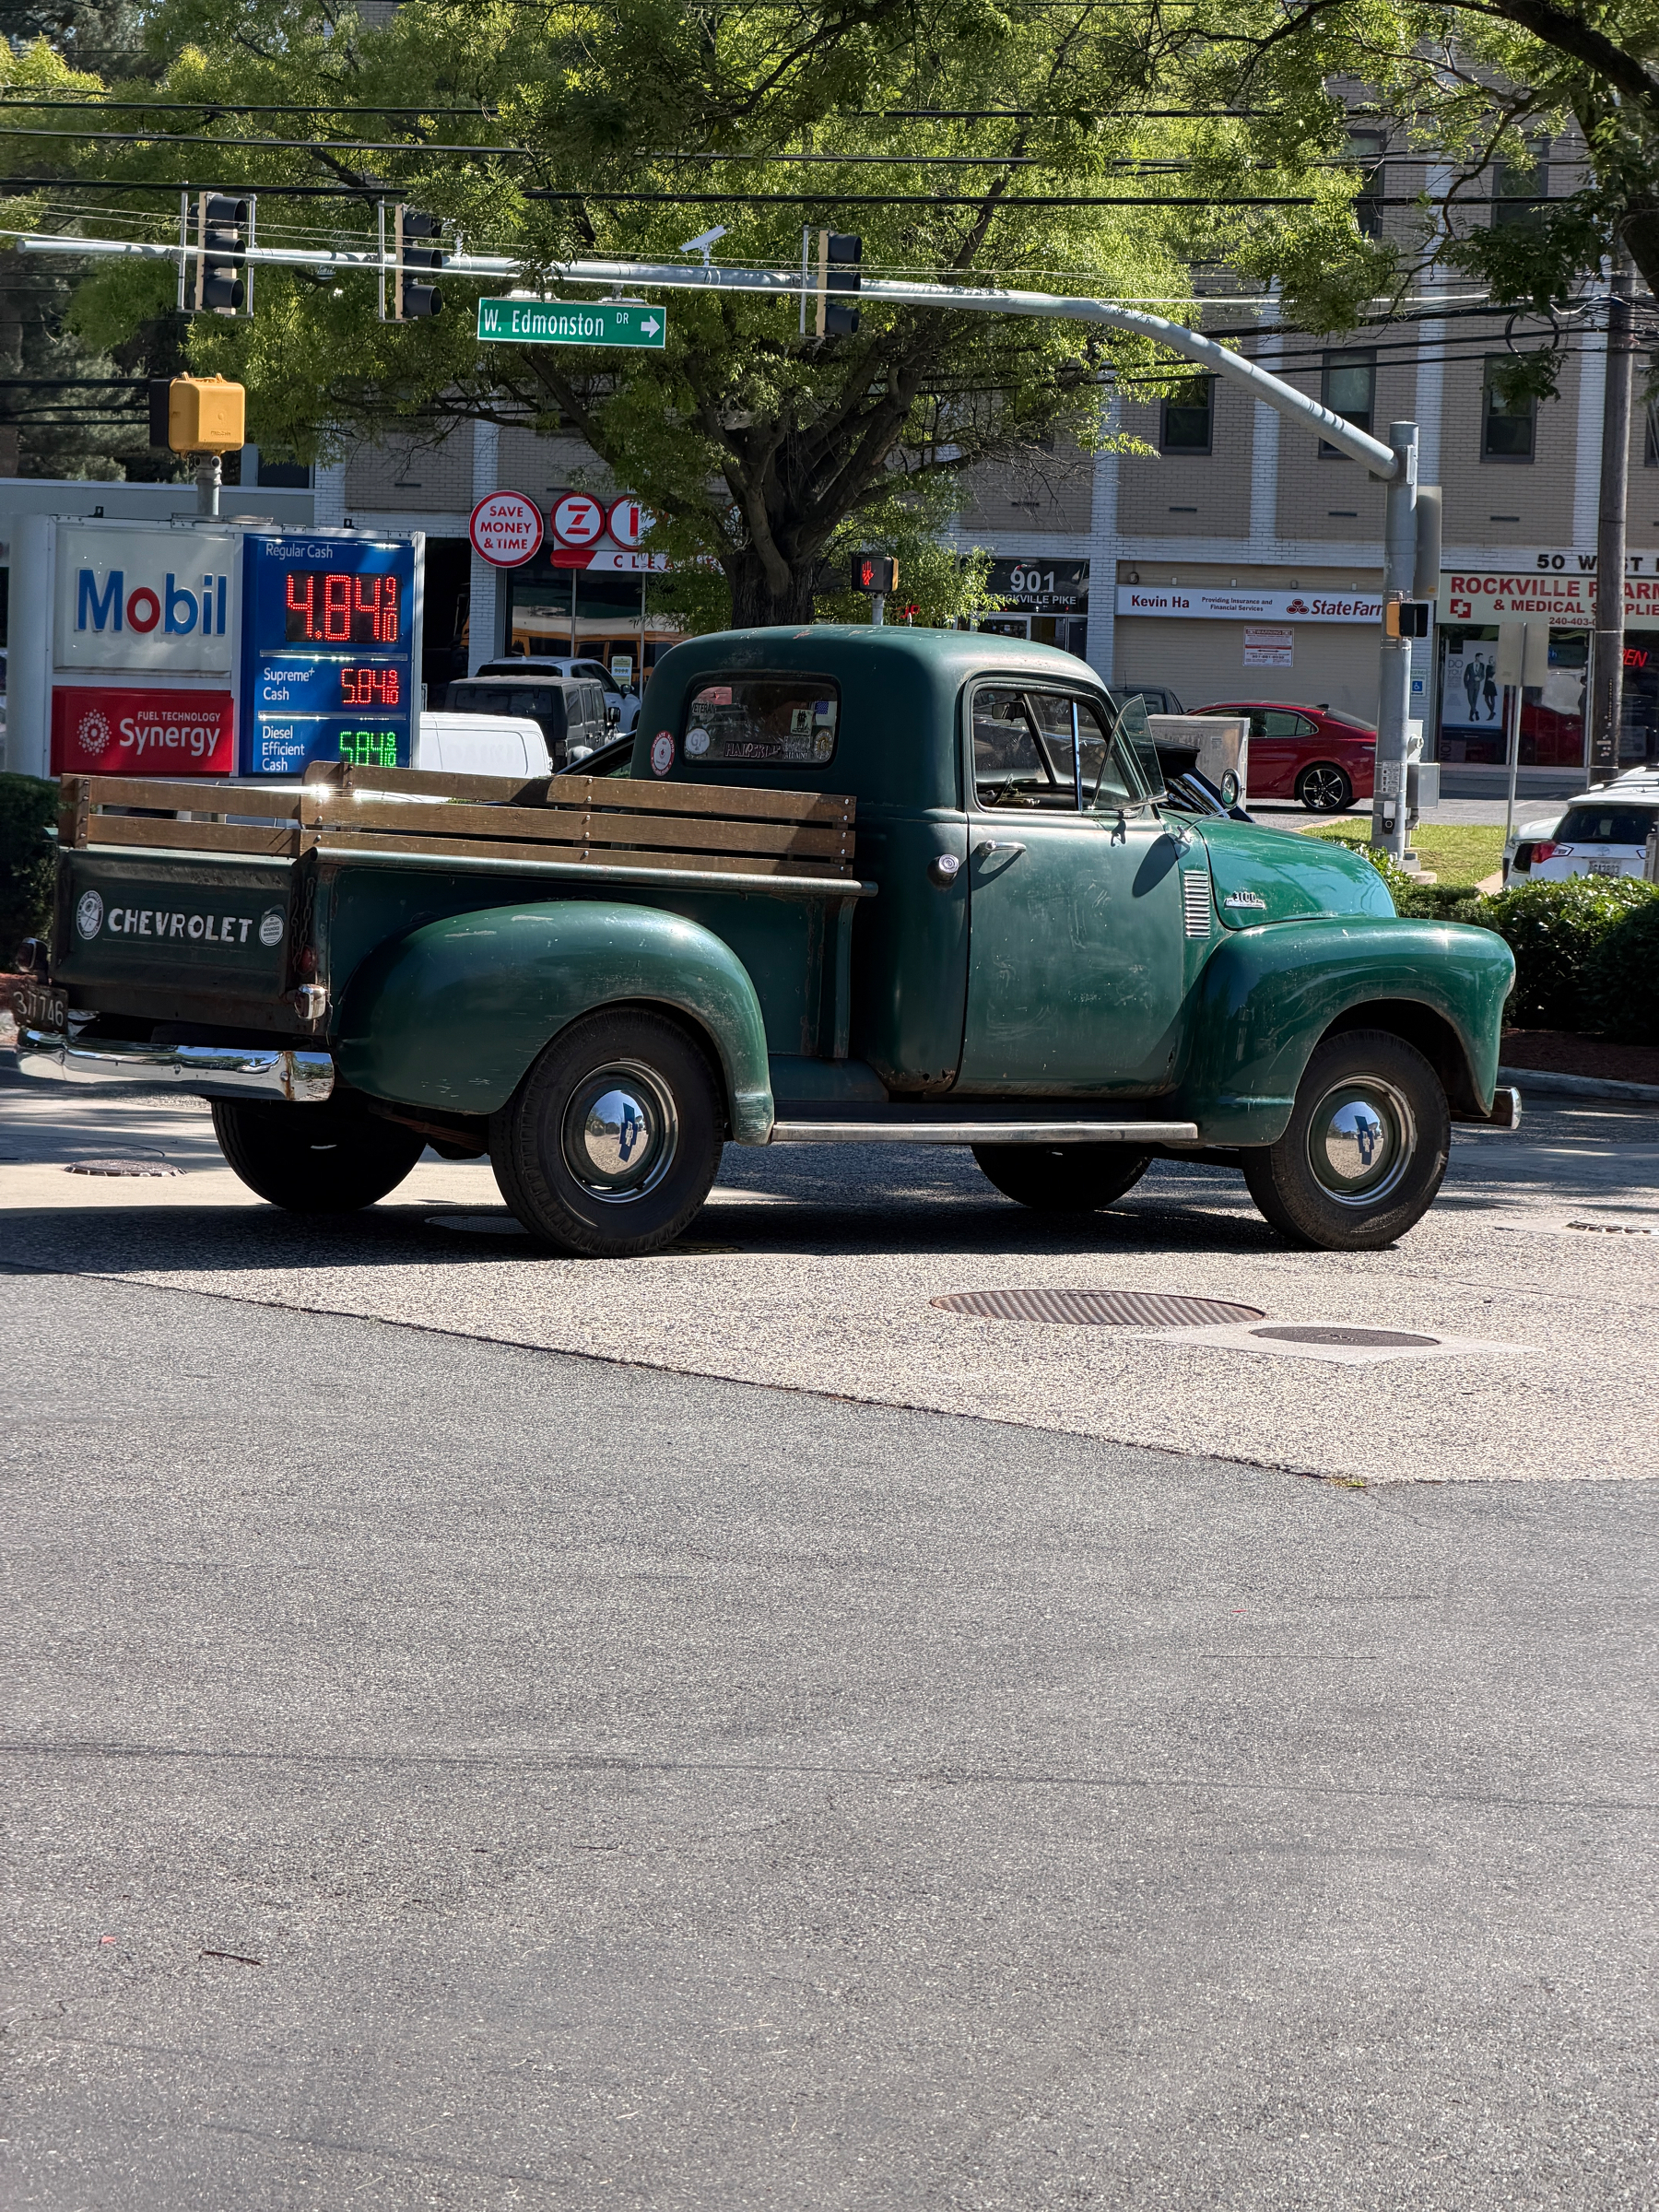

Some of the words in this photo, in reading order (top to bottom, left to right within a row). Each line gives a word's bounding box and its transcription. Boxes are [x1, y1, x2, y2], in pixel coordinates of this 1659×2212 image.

[484, 309, 501, 332] W.
[512, 309, 604, 336] Edmonston
[616, 312, 629, 324] DR
[489, 506, 524, 517] SAVE
[480, 522, 533, 534] MONEY
[484, 538, 493, 548] &
[496, 539, 528, 550] TIME
[265, 543, 305, 560] Regular
[307, 545, 333, 559] Cash
[1537, 554, 1565, 570] 50
[1010, 571, 1054, 592] 901
[1451, 577, 1580, 597] ROCKVILLE
[76, 569, 227, 636] Mobil
[1052, 595, 1077, 605] PIKE
[1131, 595, 1167, 607] Kevin
[1171, 596, 1190, 608] Ha
[1202, 596, 1230, 605] Providing
[1493, 599, 1505, 611] &
[1512, 600, 1585, 614] MEDICAL
[1448, 659, 1464, 669] DO
[263, 687, 289, 700] Cash
[137, 711, 159, 721] FUEL
[161, 712, 221, 723] TECHNOLOGY
[119, 718, 221, 757] Synergy
[262, 725, 293, 739] Diesel
[690, 733, 707, 749] GP
[262, 742, 305, 756] Efficient
[262, 758, 288, 771] Cash
[108, 908, 253, 943] CHEVROLET
